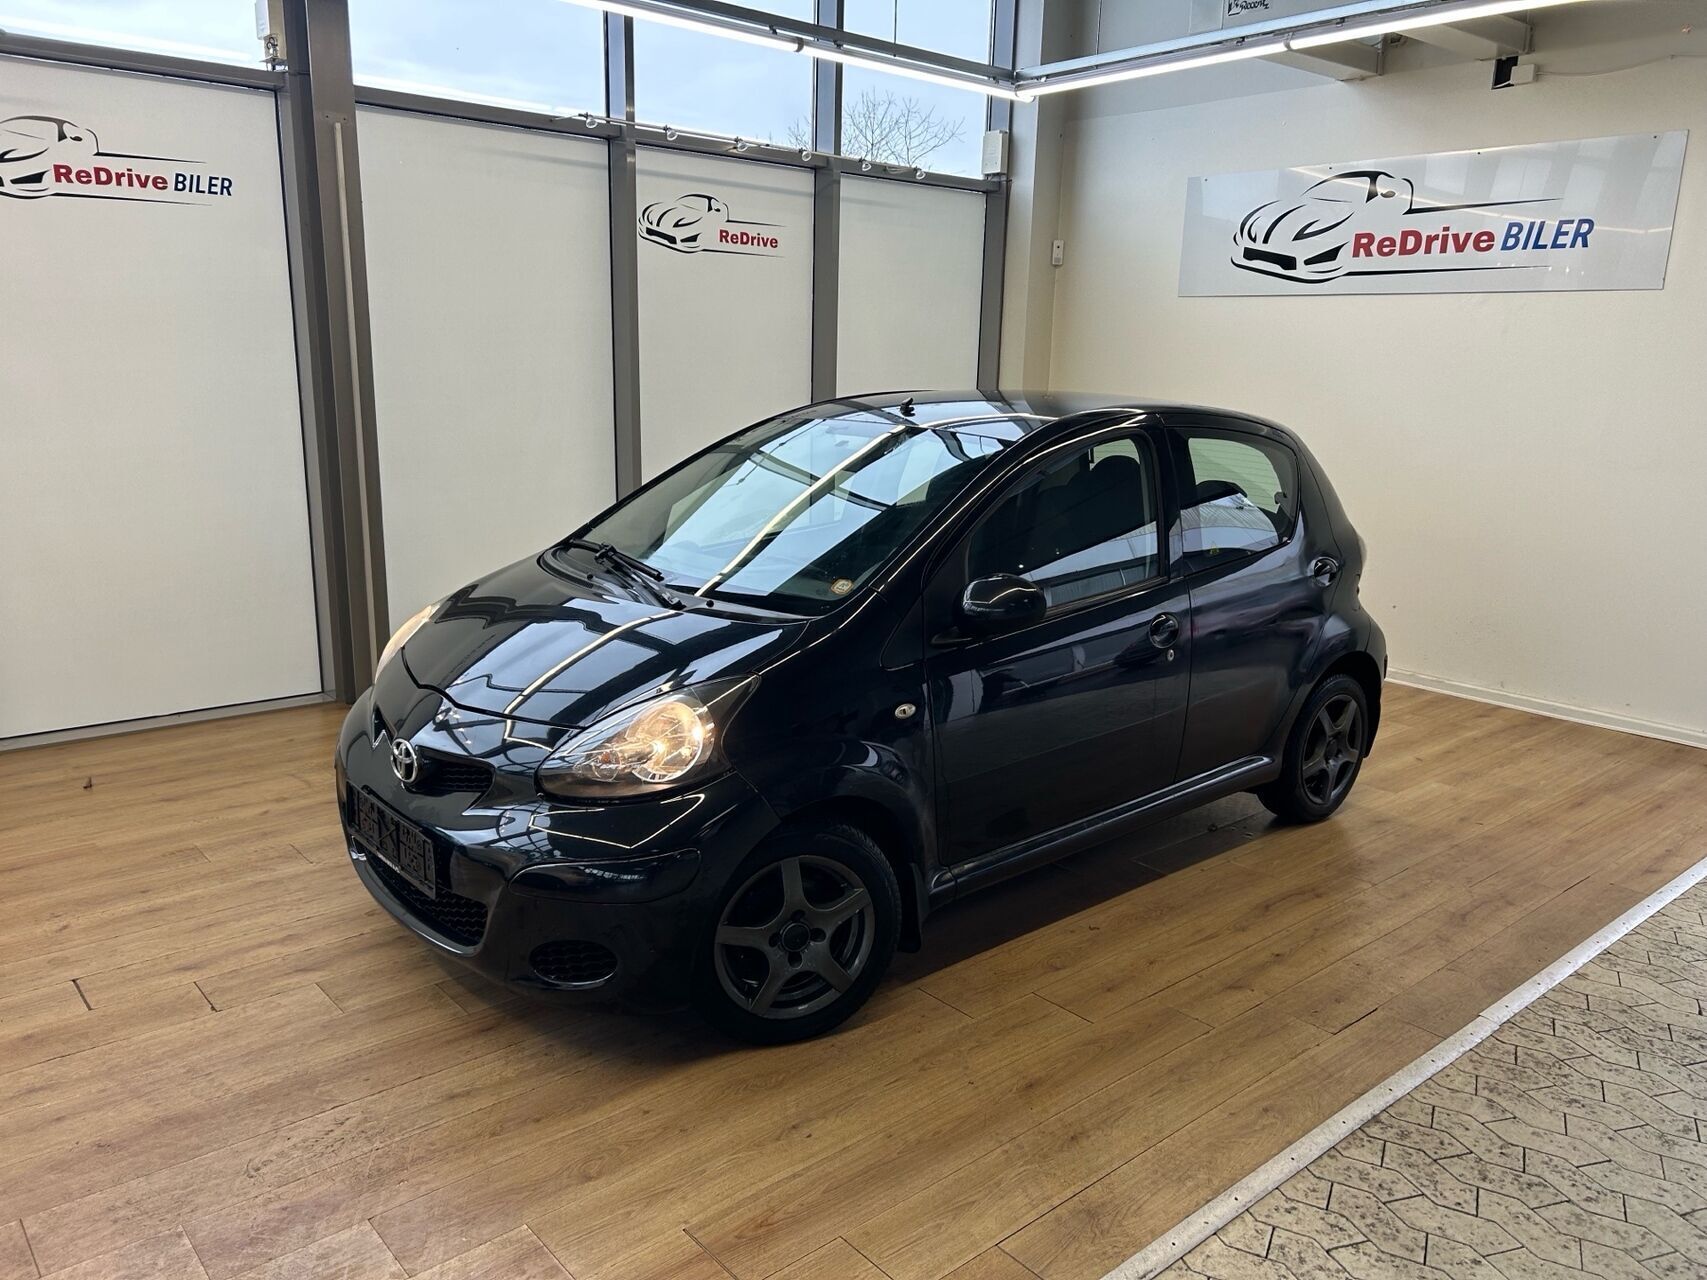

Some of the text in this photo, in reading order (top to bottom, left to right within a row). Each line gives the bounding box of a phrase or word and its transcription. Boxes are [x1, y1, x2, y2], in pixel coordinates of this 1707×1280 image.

[53, 164, 233, 197] ReDrive BILER
[719, 229, 778, 248] ReDrive
[1352, 218, 1595, 258] ReDrive BILER
